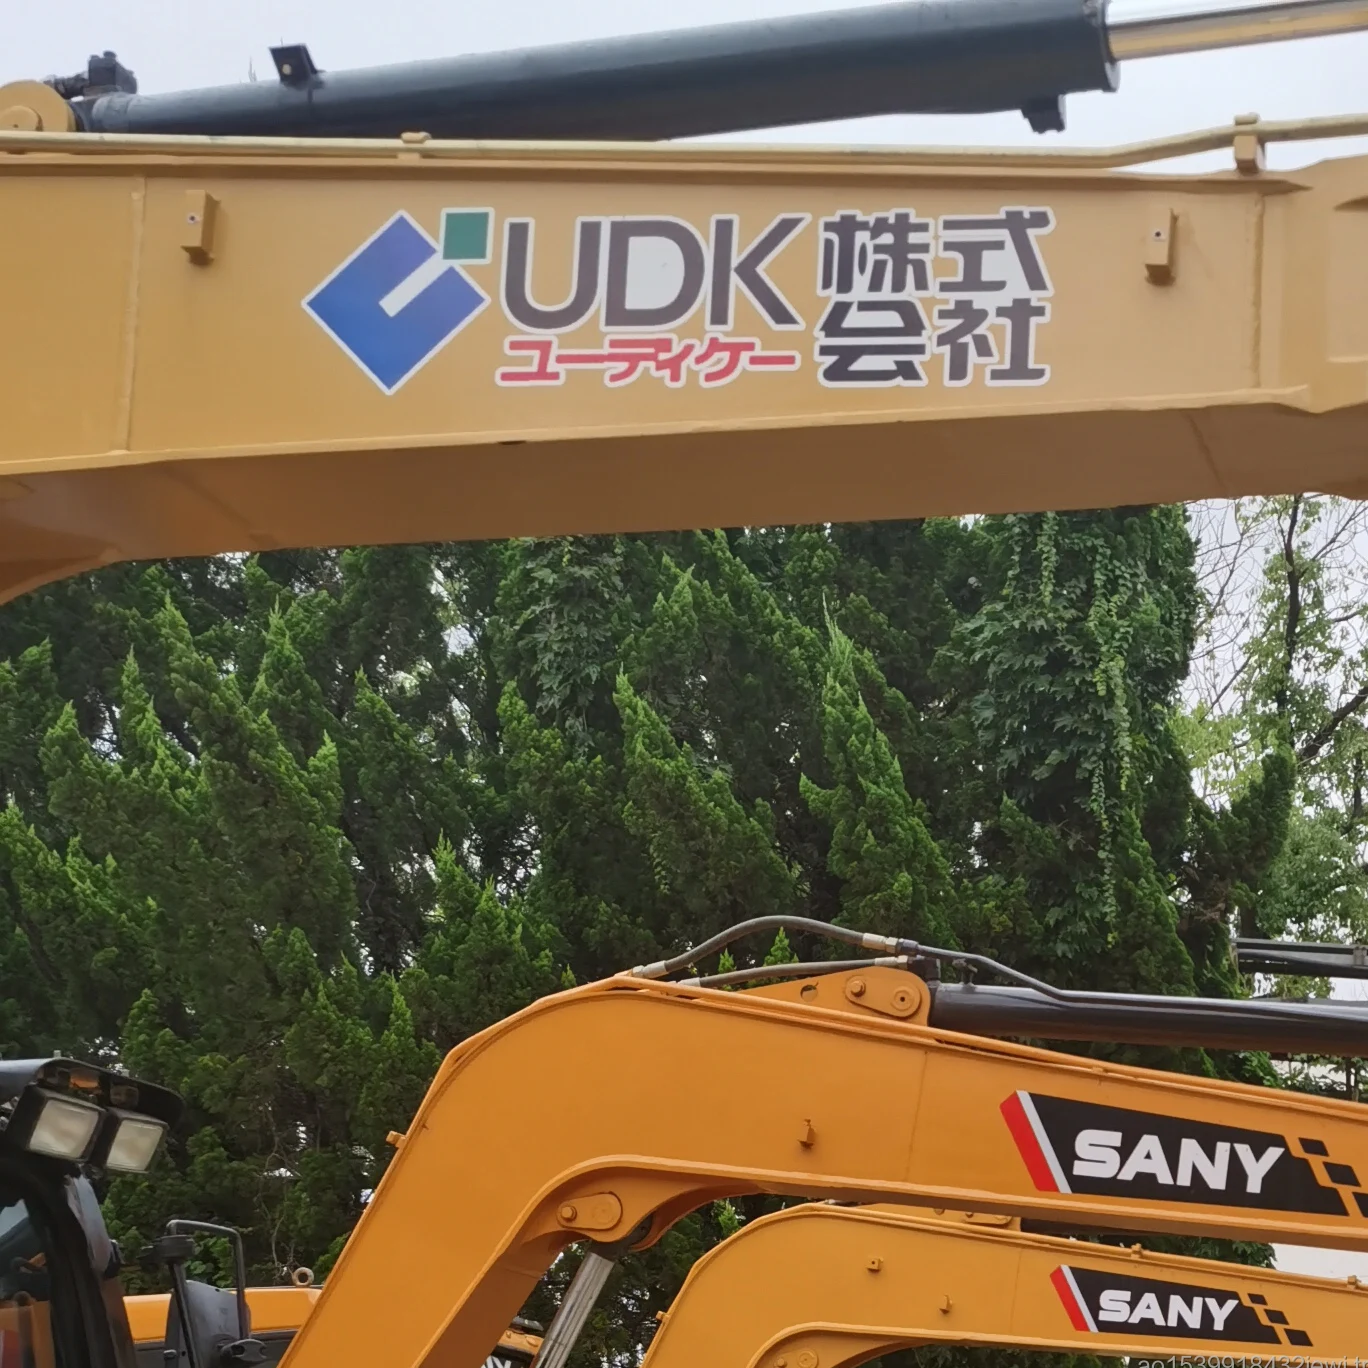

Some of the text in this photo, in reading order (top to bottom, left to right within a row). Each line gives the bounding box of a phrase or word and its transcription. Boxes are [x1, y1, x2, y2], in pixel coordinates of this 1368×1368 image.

[504, 216, 806, 330] UDK
[500, 337, 798, 383] ユーディケー
[1072, 1129, 1285, 1194] SANY
[1098, 1290, 1239, 1331] SANY
